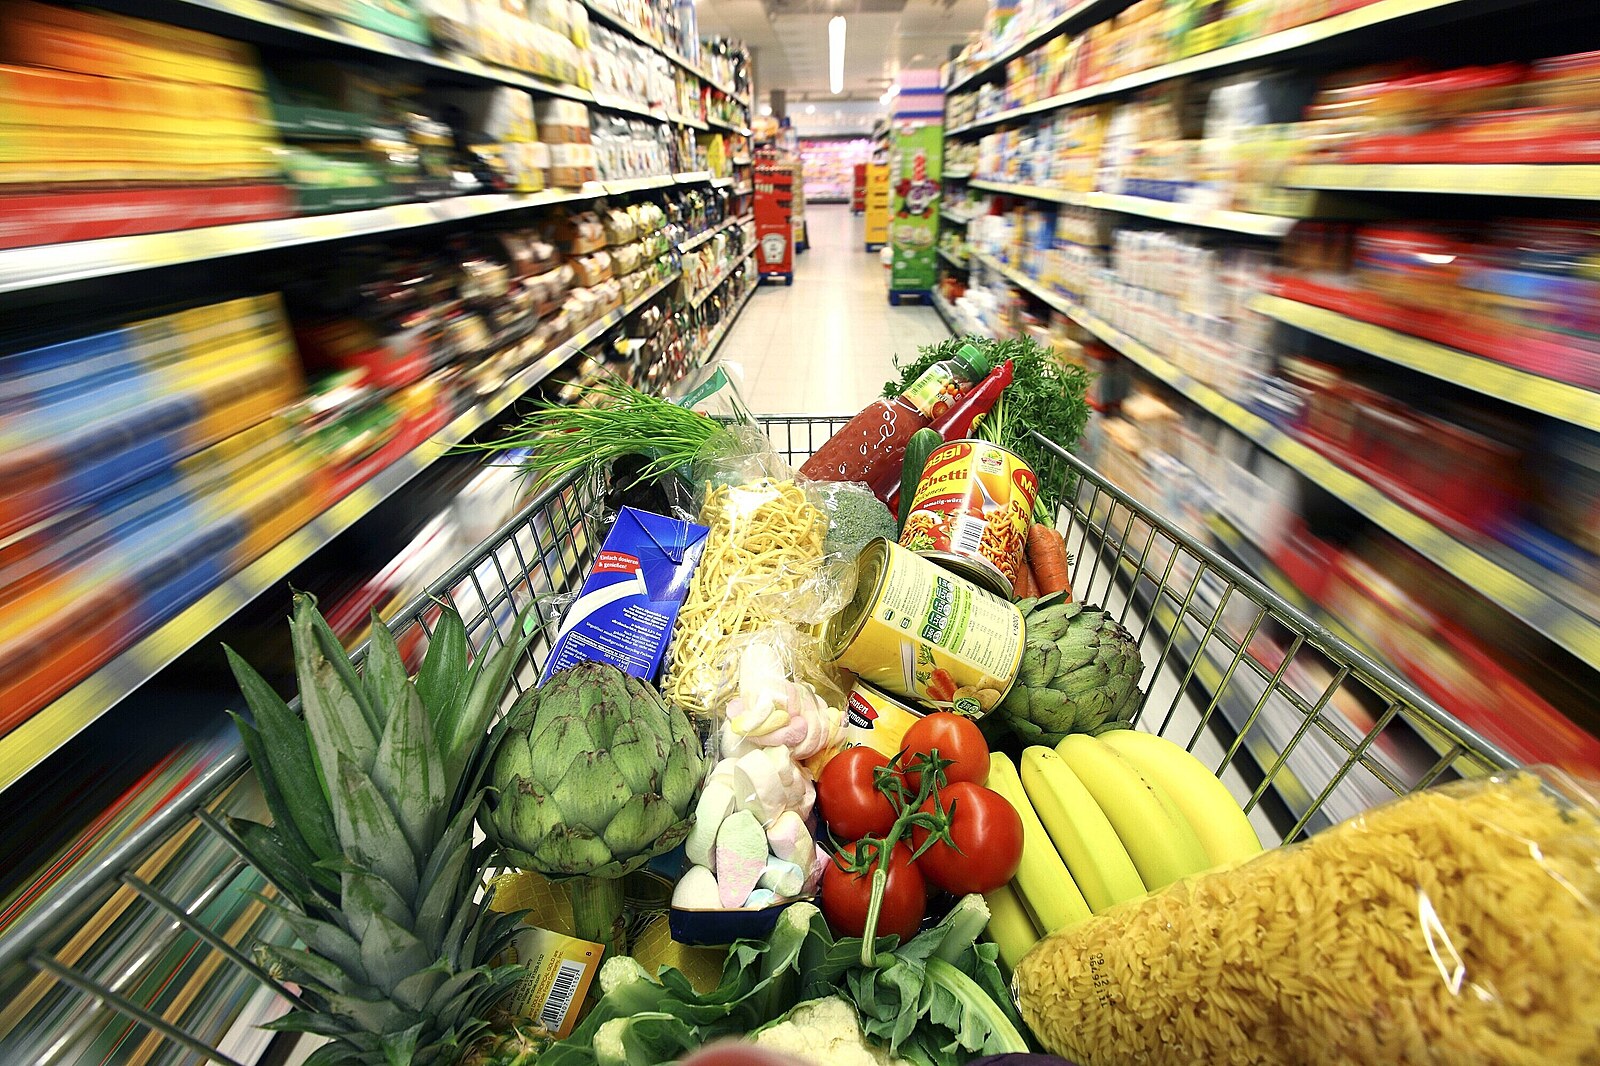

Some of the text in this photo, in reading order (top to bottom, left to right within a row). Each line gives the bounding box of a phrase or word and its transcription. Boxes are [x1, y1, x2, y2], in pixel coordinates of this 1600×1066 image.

[926, 445, 962, 468] aggi
[600, 554, 639, 565] Einfach dosieren
